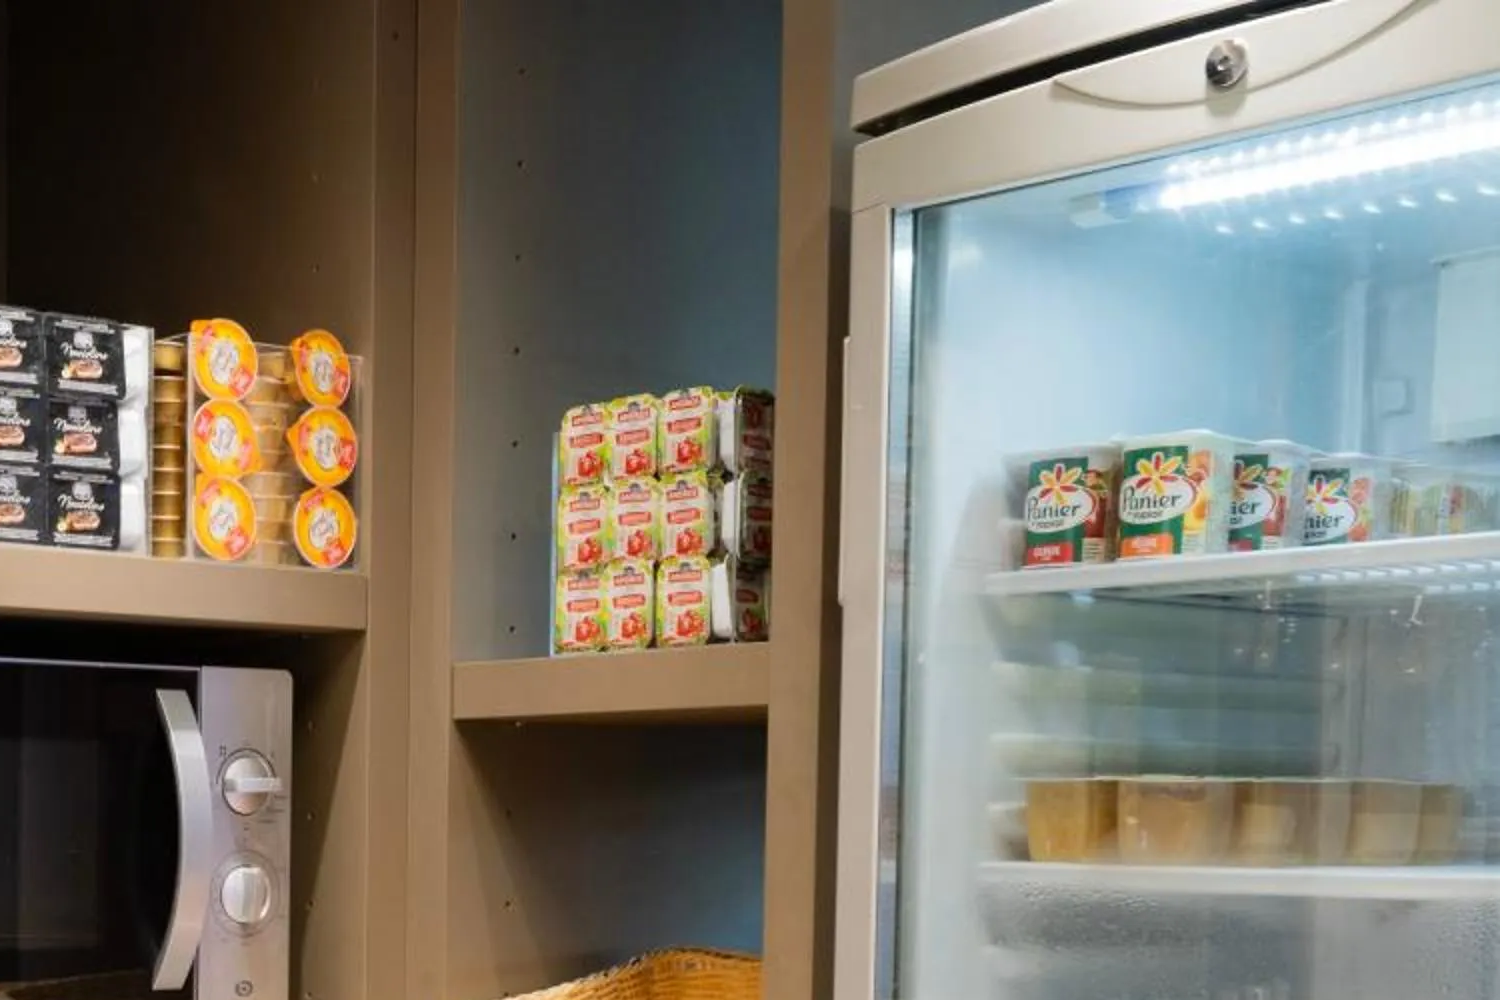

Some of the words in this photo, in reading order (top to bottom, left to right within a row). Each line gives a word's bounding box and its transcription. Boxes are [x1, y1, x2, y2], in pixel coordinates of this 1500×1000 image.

[1123, 485, 1181, 510] Panier
[1027, 496, 1080, 519] Panier
[1229, 502, 1259, 515] ier
[1304, 515, 1344, 530] nier
